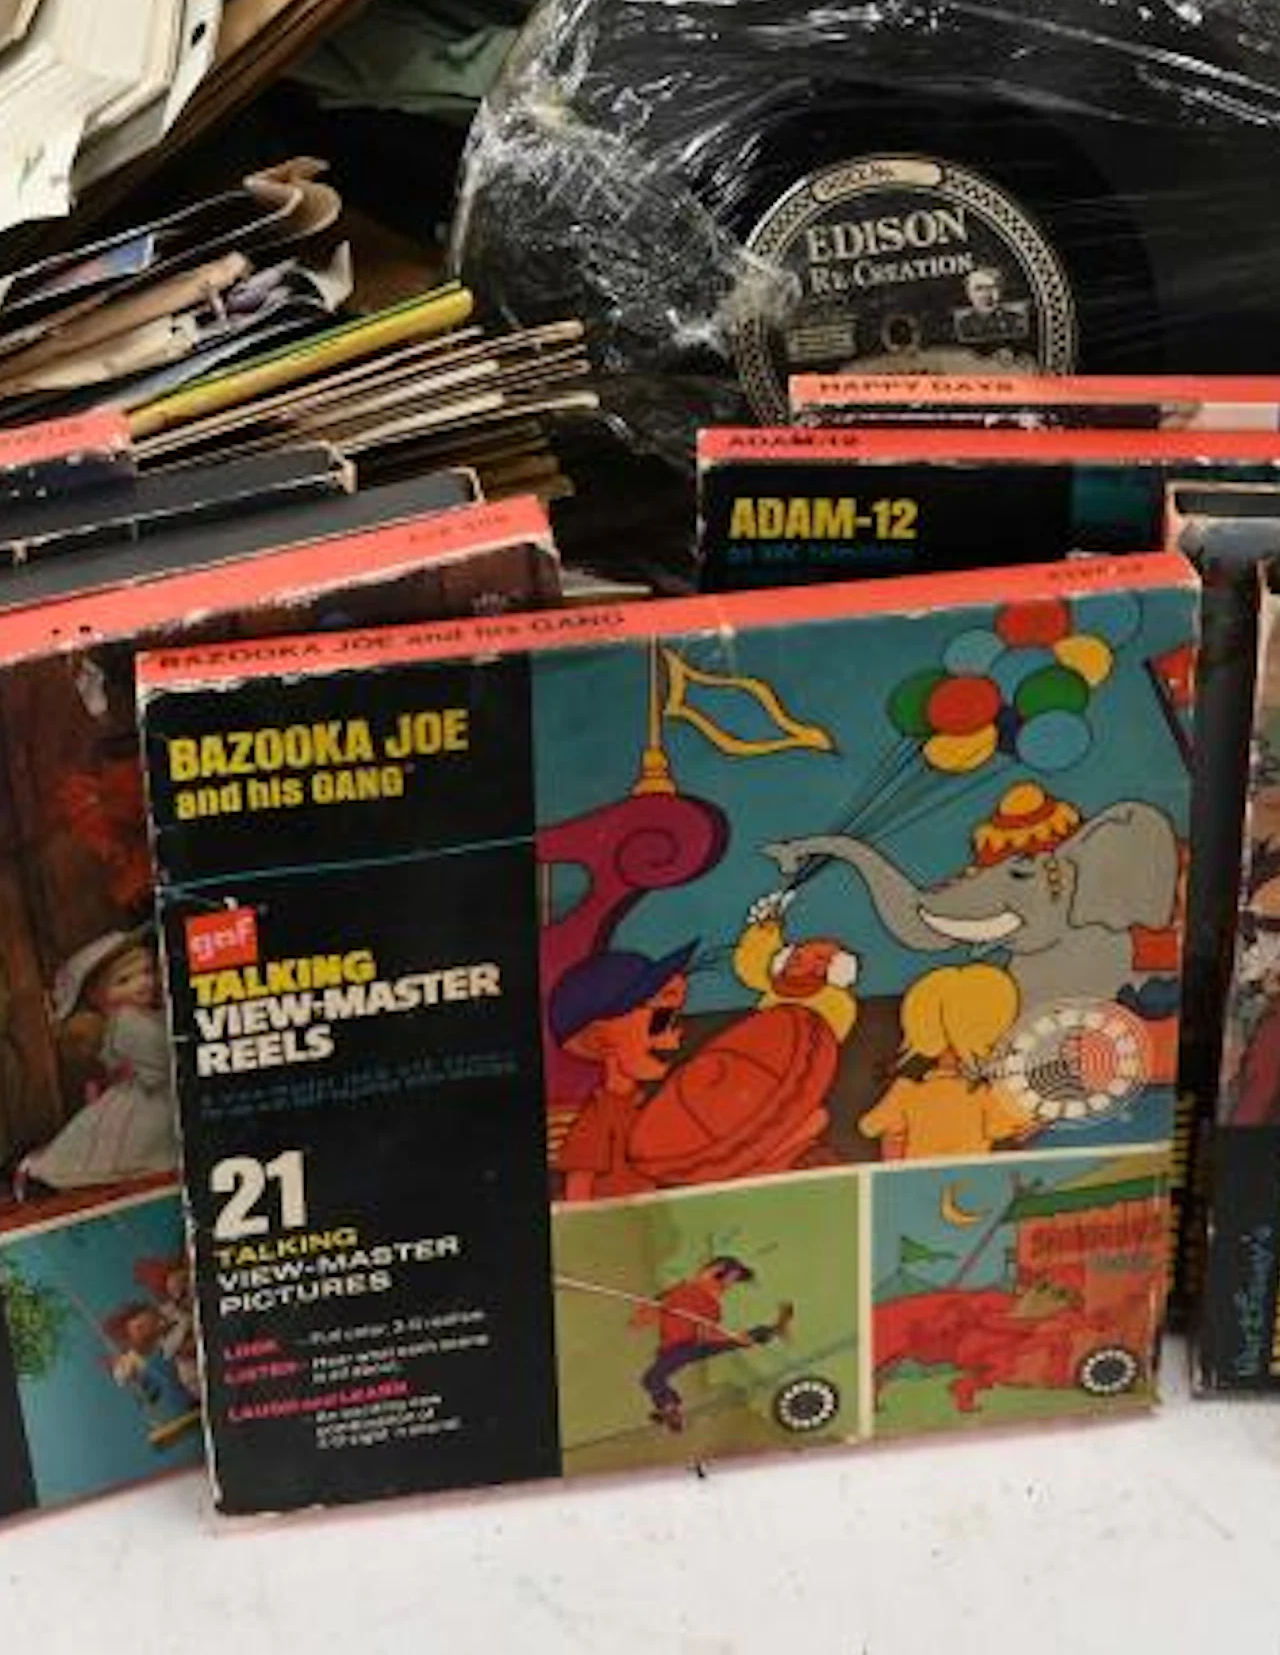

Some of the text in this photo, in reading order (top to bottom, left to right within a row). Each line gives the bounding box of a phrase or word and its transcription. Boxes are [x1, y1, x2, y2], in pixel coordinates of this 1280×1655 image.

[806, 206, 969, 263] EDISON
[819, 380, 1015, 393] HAPPY DAYS
[728, 434, 861, 448] ADAM-12
[728, 497, 919, 540] ADAM-12
[160, 642, 322, 669] BAZOOKA
[335, 636, 389, 655] JOE
[531, 613, 626, 634] GANG
[169, 708, 469, 783] BAZOOKA JOE
[175, 765, 405, 821] and his GANG
[190, 949, 377, 1006] TALKING
[194, 962, 504, 1042] VIEW-MASTER
[196, 1023, 335, 1079] REELS
[210, 1150, 308, 1240] 21
[215, 1227, 359, 1269] TALKING
[218, 1234, 461, 1292] VIEW-MASTER
[221, 1270, 392, 1316] PICTURES
